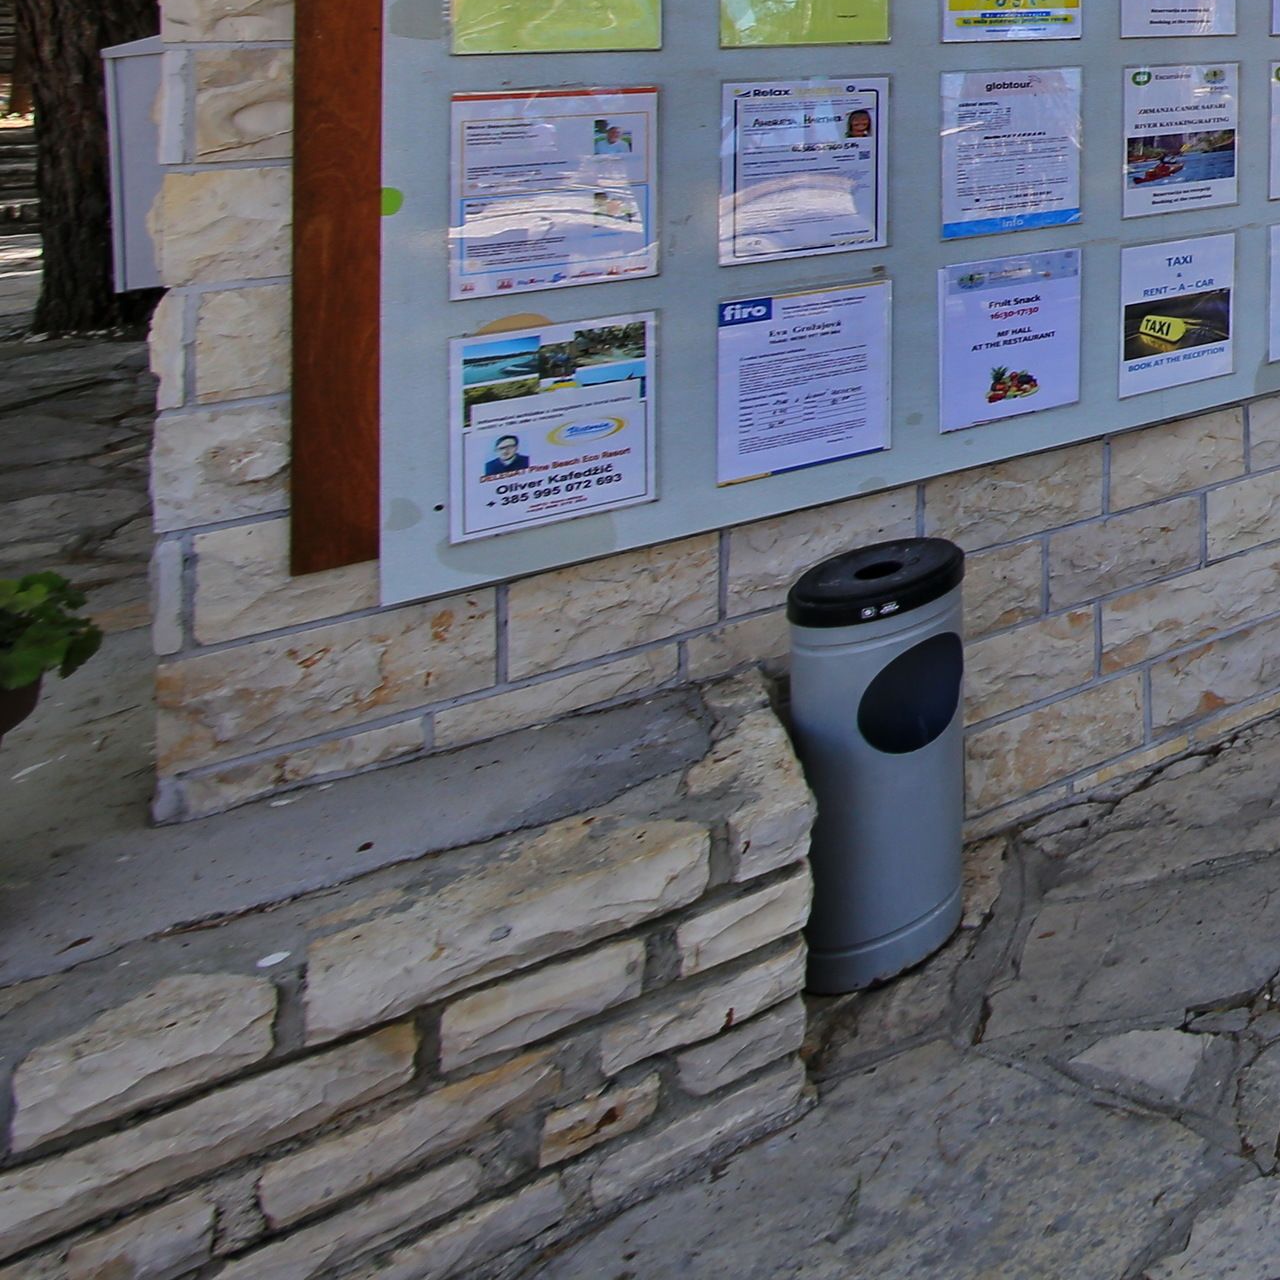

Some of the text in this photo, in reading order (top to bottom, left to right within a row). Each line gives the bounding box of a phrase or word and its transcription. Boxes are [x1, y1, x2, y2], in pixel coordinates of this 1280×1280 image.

[752, 88, 792, 98] Relax
[1134, 122, 1158, 130] RIVER
[1002, 217, 1024, 228] info
[1166, 255, 1193, 268] TAXI
[1143, 286, 1169, 297] RENT
[1178, 283, 1186, 292] A
[1195, 278, 1215, 289] CAR
[988, 294, 1041, 310] Fruit Snack
[722, 304, 767, 321] firo
[989, 306, 1040, 321] 16:30-17:30
[769, 329, 788, 338] Eva
[997, 326, 1032, 338] MF HALL
[1143, 318, 1171, 337] TAXI
[971, 331, 1056, 352] AT THE RESTAURANT
[1128, 346, 1225, 373] BOOK AT THE RECEPTION
[527, 464, 550, 473] Pine
[551, 456, 581, 470] Beach
[582, 454, 600, 464] Eco
[601, 447, 632, 459] Resort
[495, 479, 545, 495] Oliver
[500, 493, 529, 506] 385
[533, 485, 562, 500] 995
[565, 479, 593, 493] 072
[595, 472, 623, 486] 693
